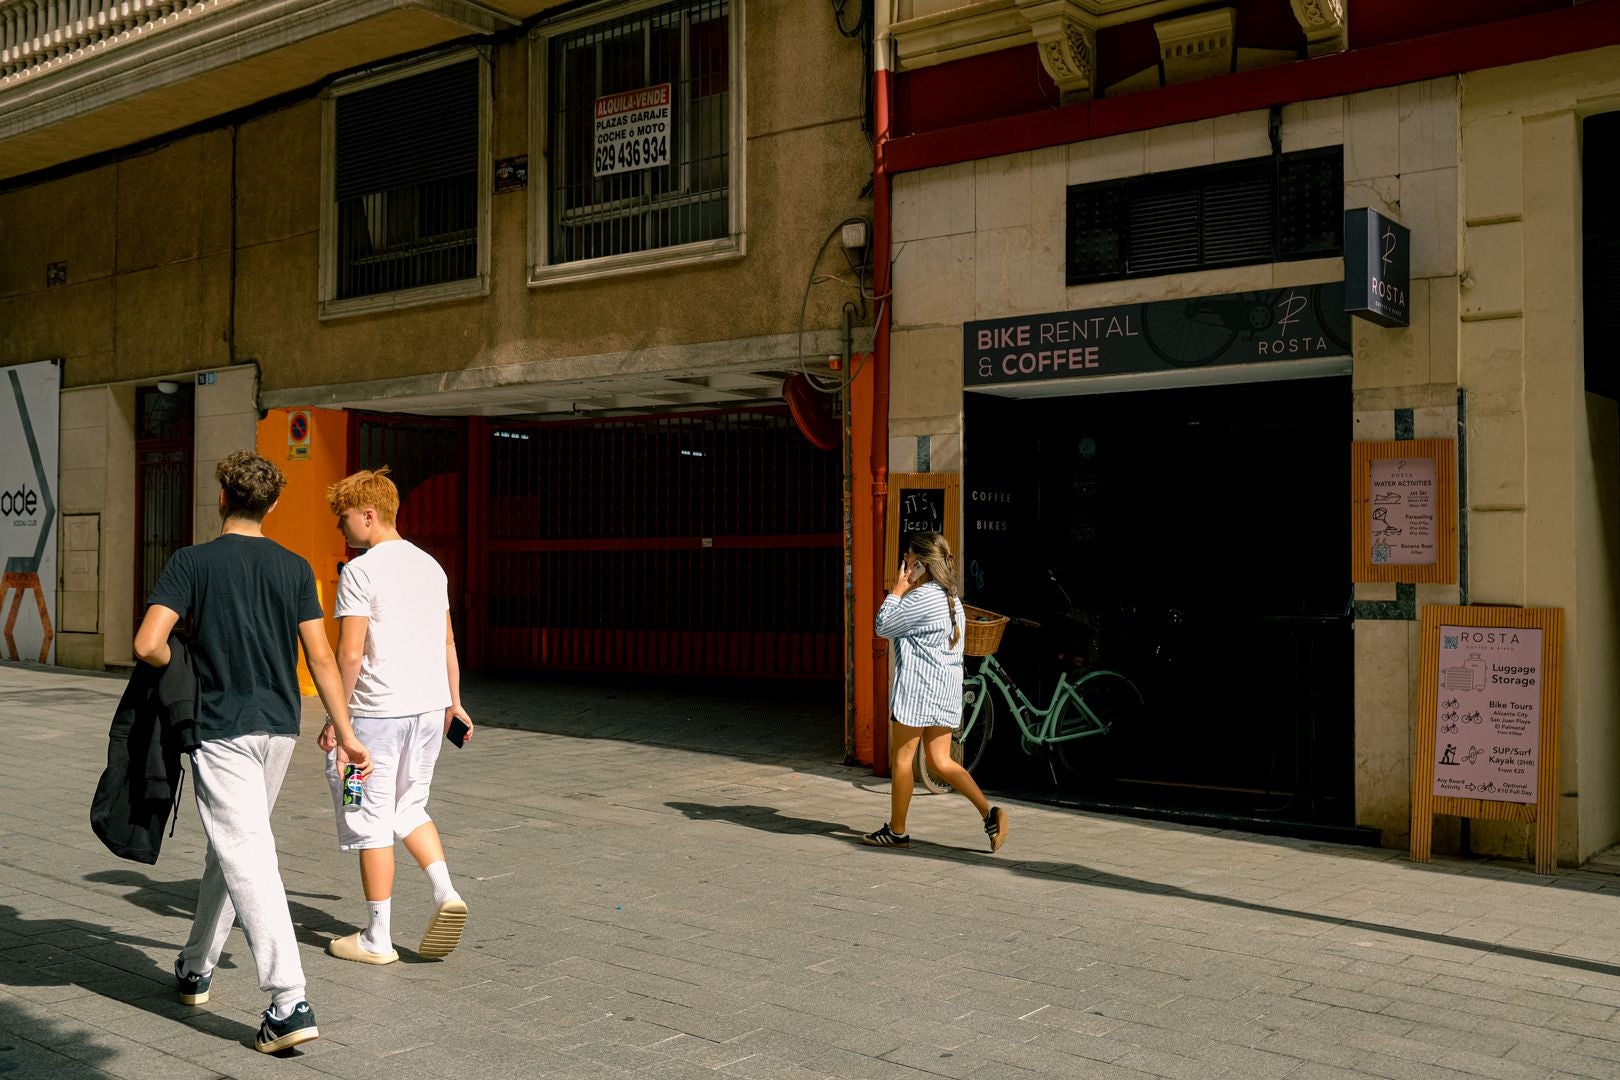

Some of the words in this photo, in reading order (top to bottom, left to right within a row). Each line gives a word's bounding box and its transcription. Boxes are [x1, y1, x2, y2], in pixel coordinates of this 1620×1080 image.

[596, 115, 628, 131] PLAZAS
[630, 108, 669, 124] GARAJE
[597, 129, 627, 144] COCHE
[637, 122, 666, 136] MOTO
[595, 144, 616, 173] 629
[618, 139, 641, 168] 436
[642, 135, 667, 164] 934
[1371, 277, 1405, 307] ROSTA
[977, 325, 1031, 351] BIKE
[1040, 315, 1139, 345] RENTAL
[1258, 337, 1327, 355] ROSTA
[978, 356, 993, 377] &
[1002, 346, 1099, 375] COFFEE
[972, 490, 1012, 503] COFFEE
[976, 520, 1008, 531] BIKES
[1461, 632, 1520, 644] ROSTA
[1492, 663, 1536, 675] Luggage
[1491, 674, 1536, 687] Storage
[1489, 700, 1508, 709] Bike
[1510, 701, 1533, 711] Tours
[1492, 746, 1532, 757] SUP/Surf
[1489, 756, 1515, 766] Kayak
[1502, 782, 1528, 790] Optional
